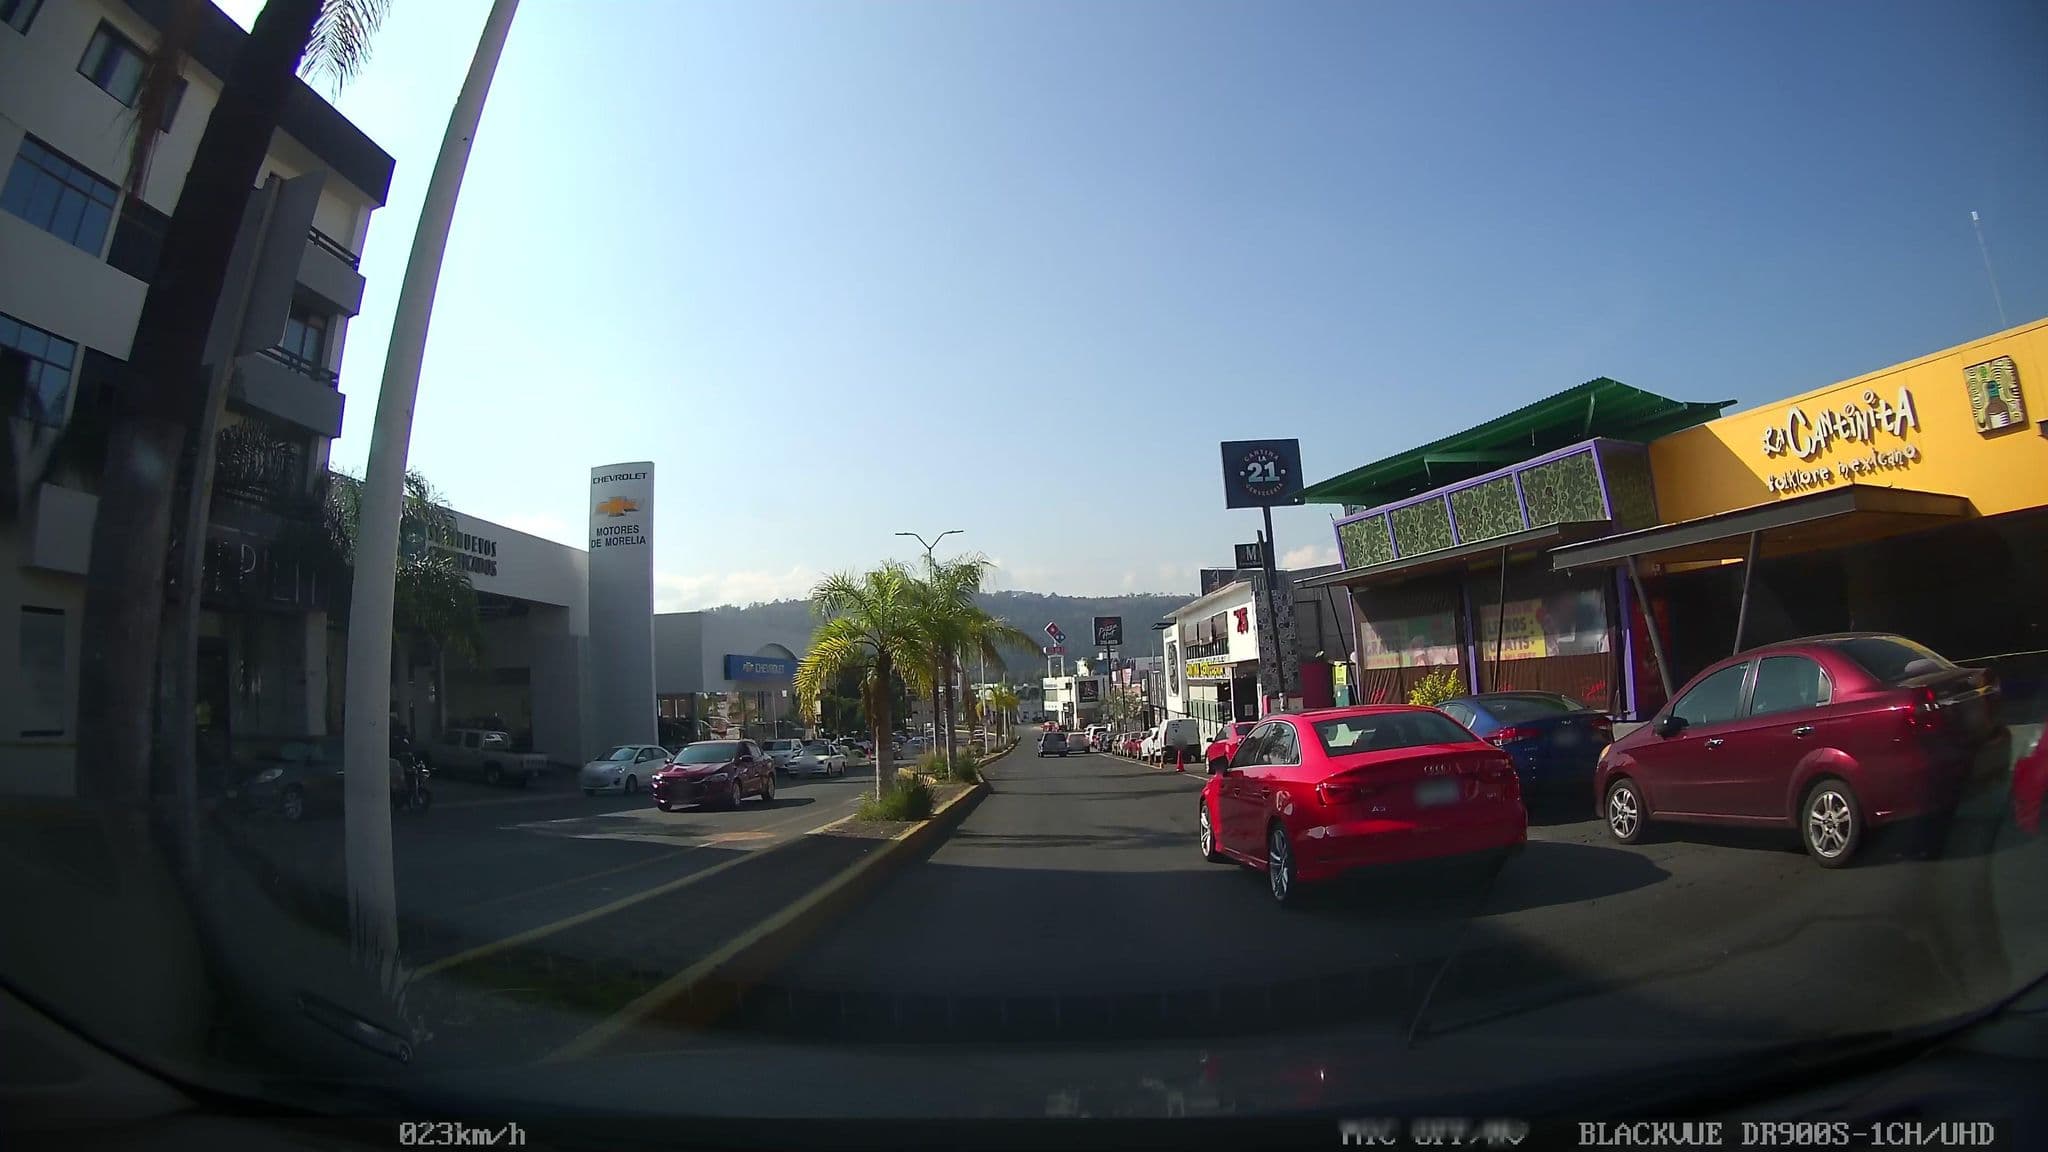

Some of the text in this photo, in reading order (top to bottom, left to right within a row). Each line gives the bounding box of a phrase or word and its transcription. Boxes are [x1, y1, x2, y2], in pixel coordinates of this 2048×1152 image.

[1244, 449, 1280, 462] CANTINA
[592, 472, 647, 484] CHEVROLET
[1247, 462, 1280, 483] 21
[596, 525, 640, 537] MOTORES
[591, 536, 647, 549] DE MORELIA
